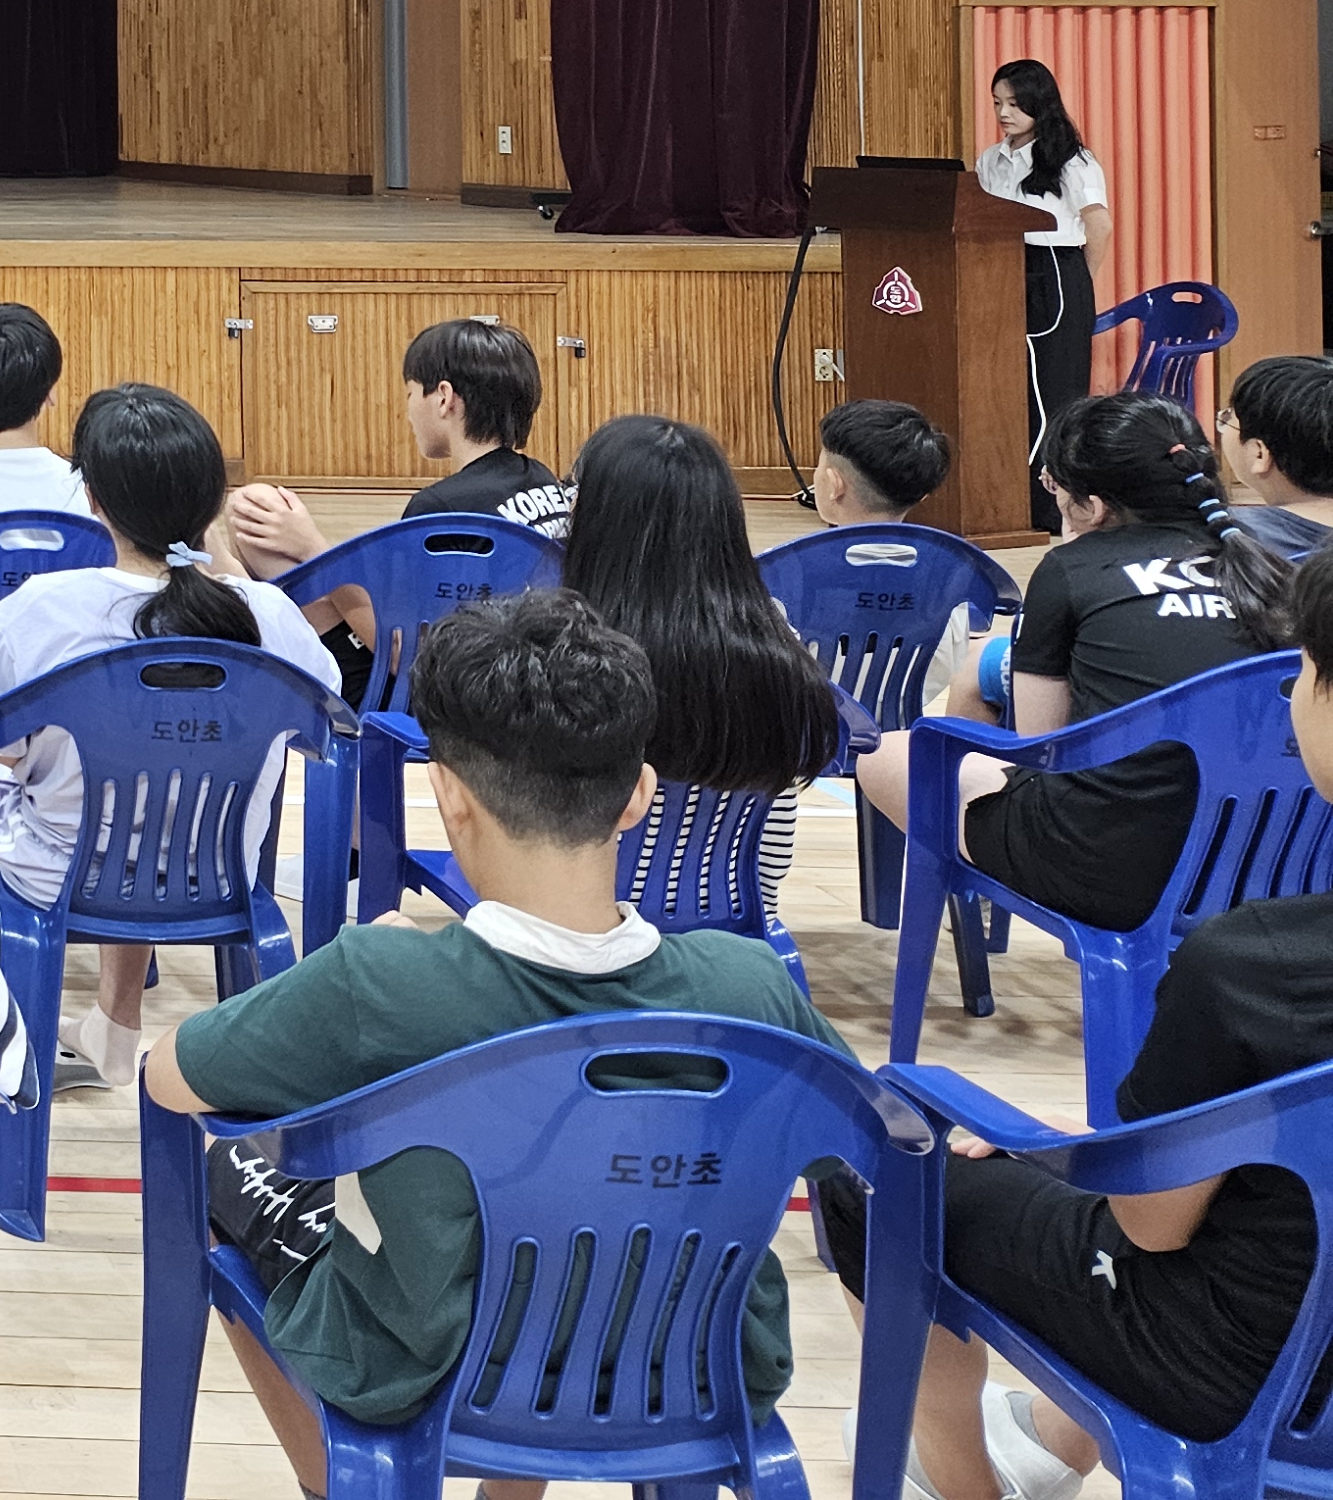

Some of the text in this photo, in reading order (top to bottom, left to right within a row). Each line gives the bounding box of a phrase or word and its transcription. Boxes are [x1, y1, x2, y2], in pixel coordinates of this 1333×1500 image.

[854, 591, 915, 610] 도안초
[1157, 593, 1237, 619] AIR
[151, 718, 222, 743] 도안초
[605, 1153, 722, 1188] 도안초
